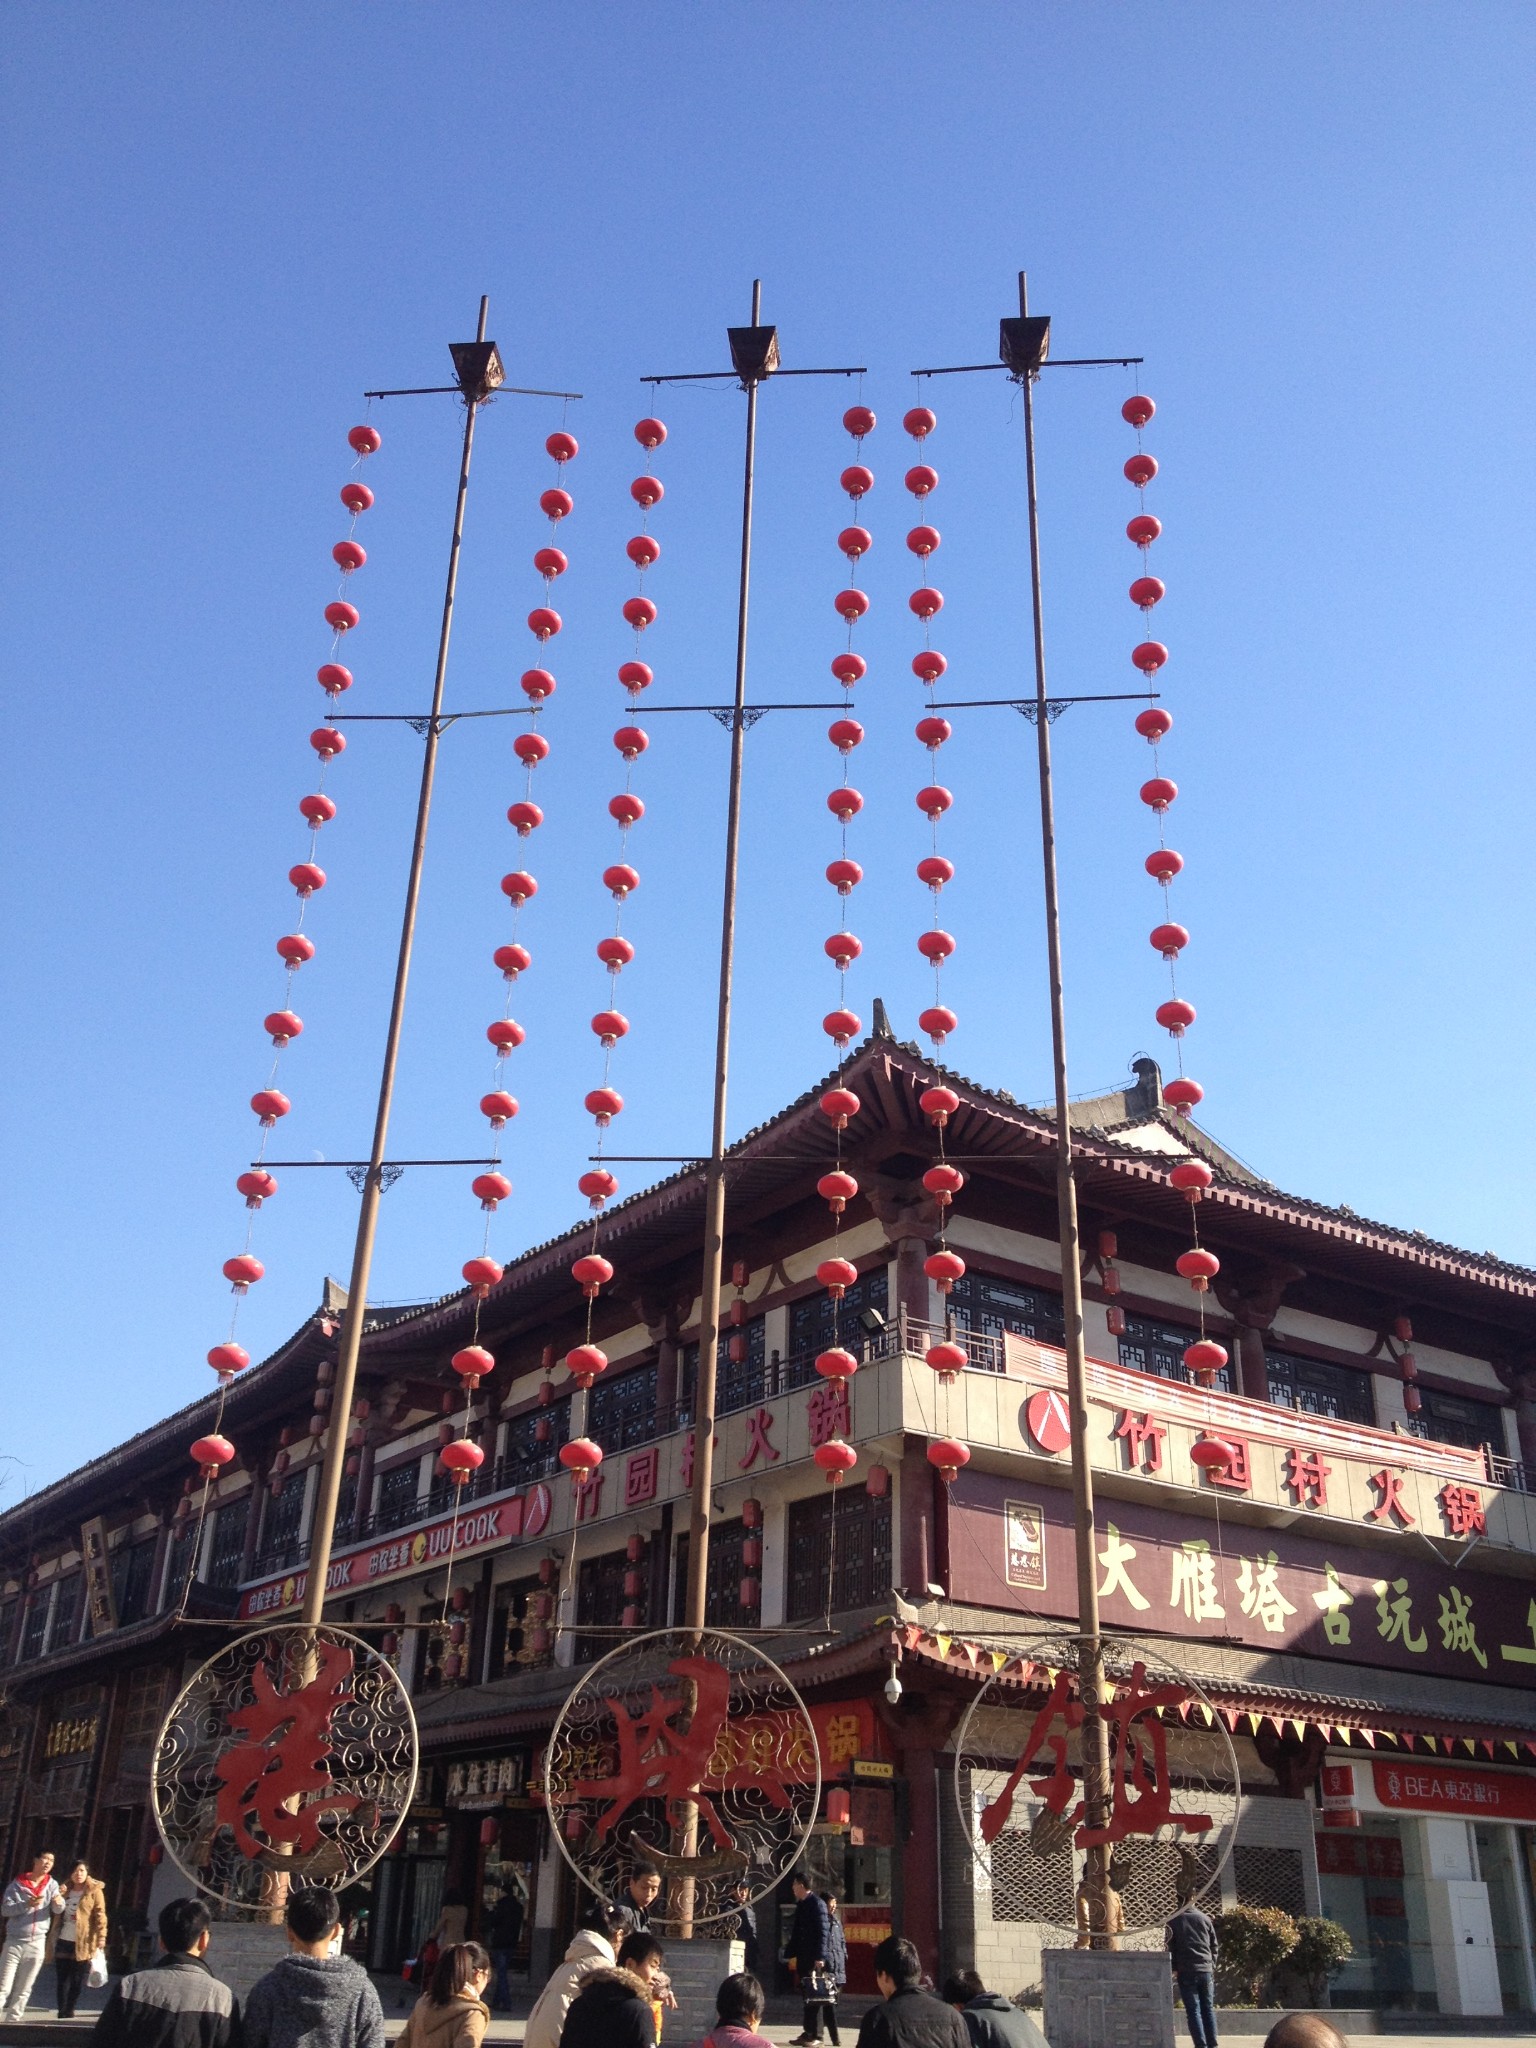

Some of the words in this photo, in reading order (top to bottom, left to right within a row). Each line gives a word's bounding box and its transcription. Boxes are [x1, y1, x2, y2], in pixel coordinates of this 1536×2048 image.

[1117, 1408, 1486, 1536] 竹园村火锅
[429, 1510, 499, 1556] UUCOOK
[1098, 1521, 1536, 1670] 大雁塔古玩城
[1404, 1776, 1443, 1798] BEA
